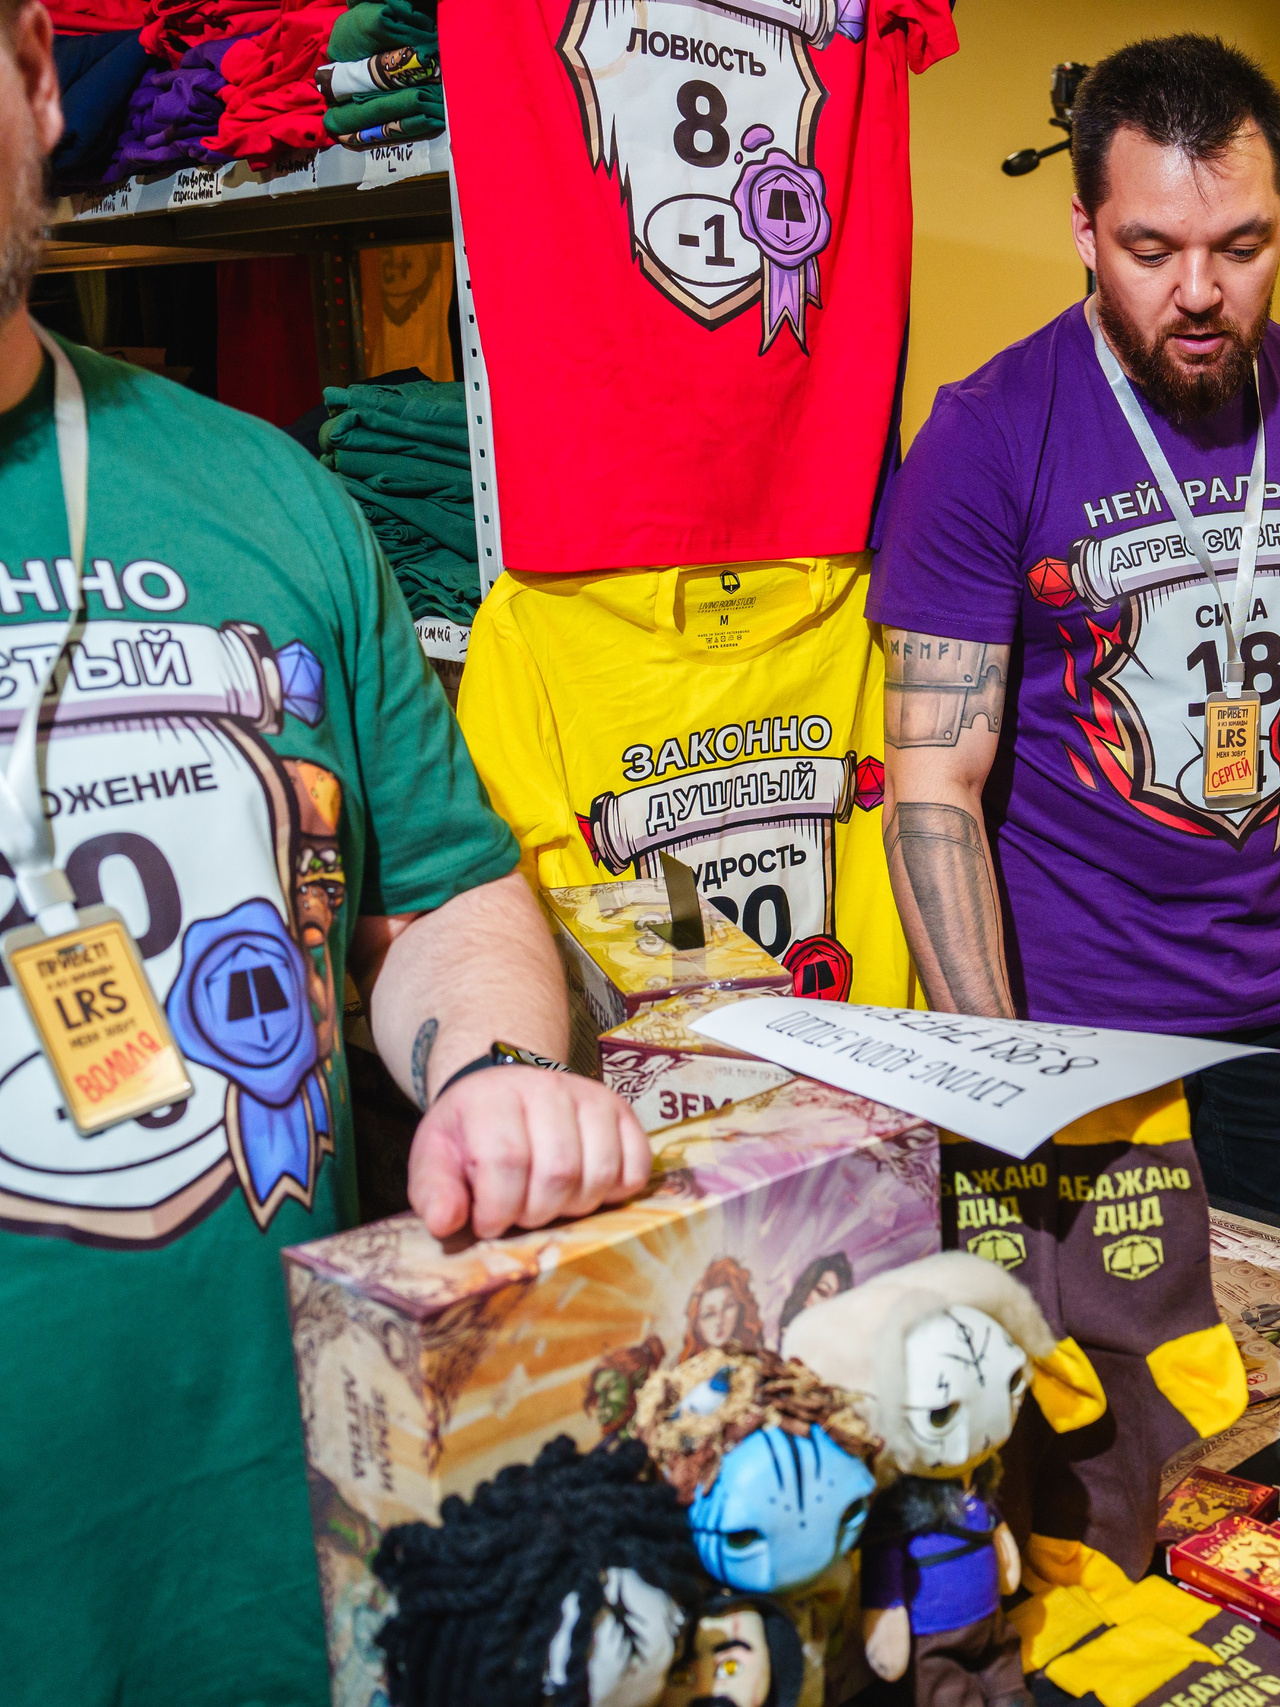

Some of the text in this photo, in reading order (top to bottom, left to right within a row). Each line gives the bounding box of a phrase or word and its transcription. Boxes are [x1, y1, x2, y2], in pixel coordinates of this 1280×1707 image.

[626, 27, 766, 77] ЛОВКОСТЬ
[673, 79, 731, 168] 8
[678, 214, 735, 268] -1
[699, 601, 719, 610] LIVING
[720, 599, 736, 608] ROOM
[736, 597, 756, 606] STUDIO
[720, 615, 728, 625] M
[1195, 598, 1268, 629] СИА
[1217, 708, 1249, 720] ПРИВЕТ!
[622, 715, 833, 782] ЗАКОННО
[1217, 728, 1247, 748] LRS
[1211, 757, 1252, 789] СЕРГЕЙ
[647, 762, 816, 836] ДУШНЫЙ
[54, 979, 128, 1030] LRS
[766, 1010, 1027, 1108] LIVING ROOM STUDIO
[1058, 1166, 1191, 1202] АБАЖАЮ
[958, 1196, 1022, 1229] ДНД
[1093, 1196, 1164, 1236] ДНД
